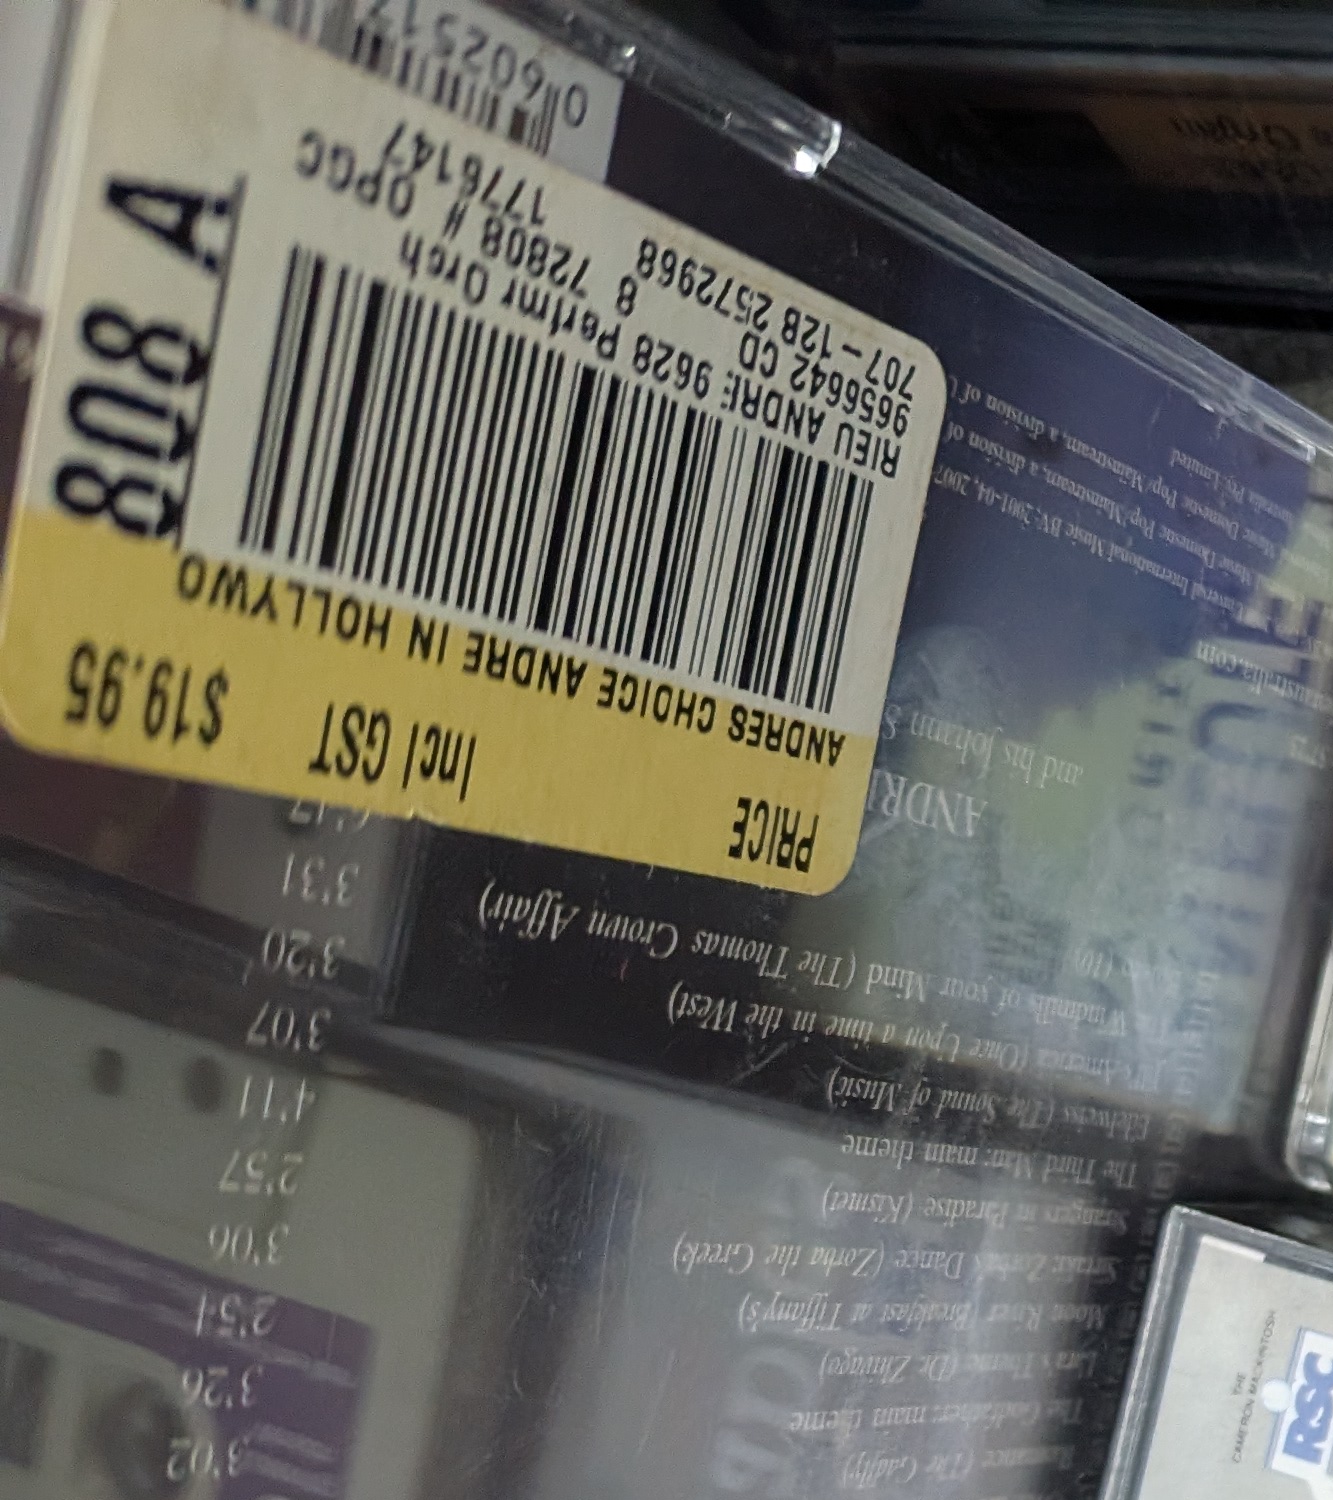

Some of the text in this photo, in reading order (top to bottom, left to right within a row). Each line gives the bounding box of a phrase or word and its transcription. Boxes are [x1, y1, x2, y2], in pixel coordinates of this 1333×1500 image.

[376, 119, 780, 333] 2572968 1776147
[53, 178, 243, 541] 808 A
[389, 229, 907, 481] RIEU ANDRE 9628 Orch
[472, 213, 916, 437] 9656642 CD 8 72808
[171, 553, 396, 655] HOLLYWO
[1103, 542, 1191, 598] International
[403, 616, 451, 665] IN
[458, 630, 588, 701] ANDRE
[594, 666, 719, 736] CHOICE
[53, 628, 823, 877] PRICE Incl GST $19.95
[724, 701, 847, 769] ANDRES
[278, 850, 817, 1043] in the West) 3'31
[474, 875, 930, 999] Mind (The Thomas Crown Affair)
[259, 922, 902, 1115] Music) 3'20
[236, 1067, 914, 1230] (Kismet) 4'11
[245, 996, 977, 1176] main theme 3'07
[204, 1213, 291, 1269] 3'06
[218, 1141, 964, 1279] Dance (Zorba the Greek) 2'57
[177, 1353, 264, 1414] 3'26
[163, 1425, 249, 1489] 3'02
